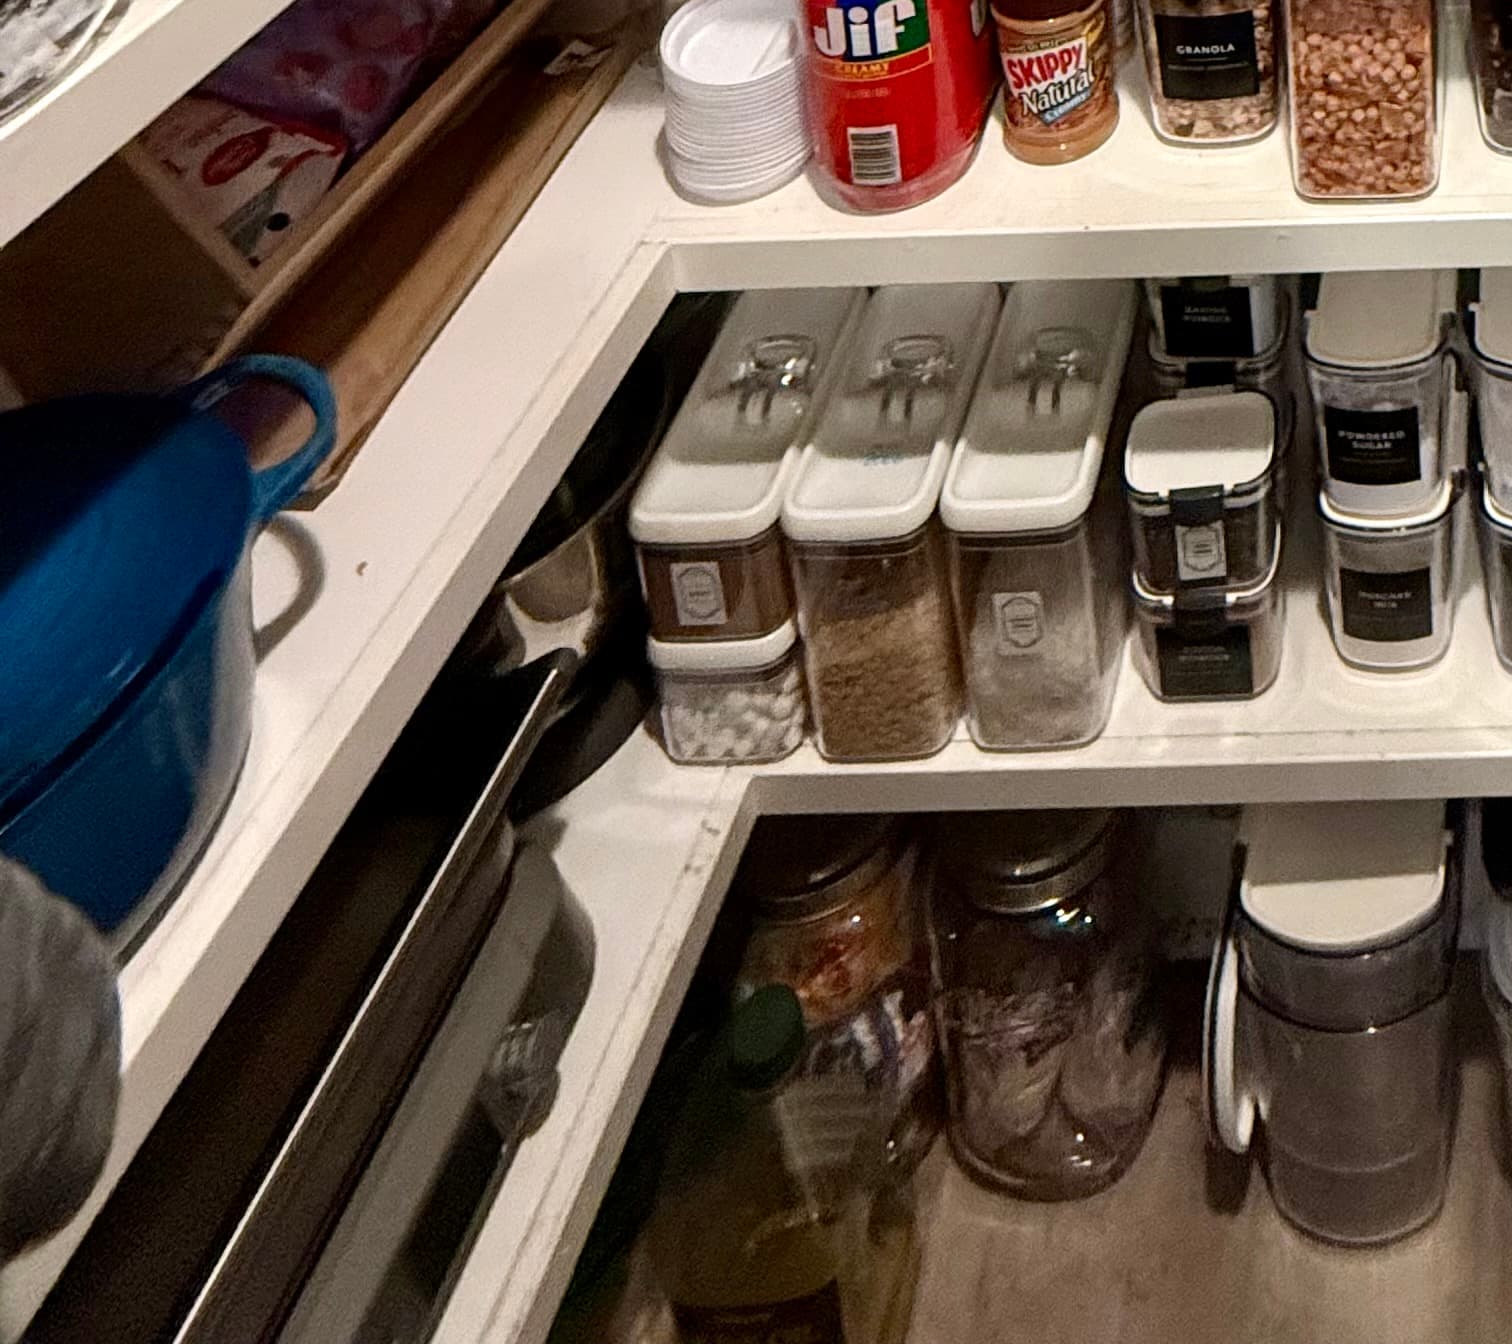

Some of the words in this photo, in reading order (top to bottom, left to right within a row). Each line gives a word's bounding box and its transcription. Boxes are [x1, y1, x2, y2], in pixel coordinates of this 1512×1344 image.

[1176, 44, 1236, 56] GRANOLA
[1006, 42, 1084, 91] SKIPPY
[1019, 65, 1095, 117] Natural
[1351, 440, 1393, 450] SUGAR
